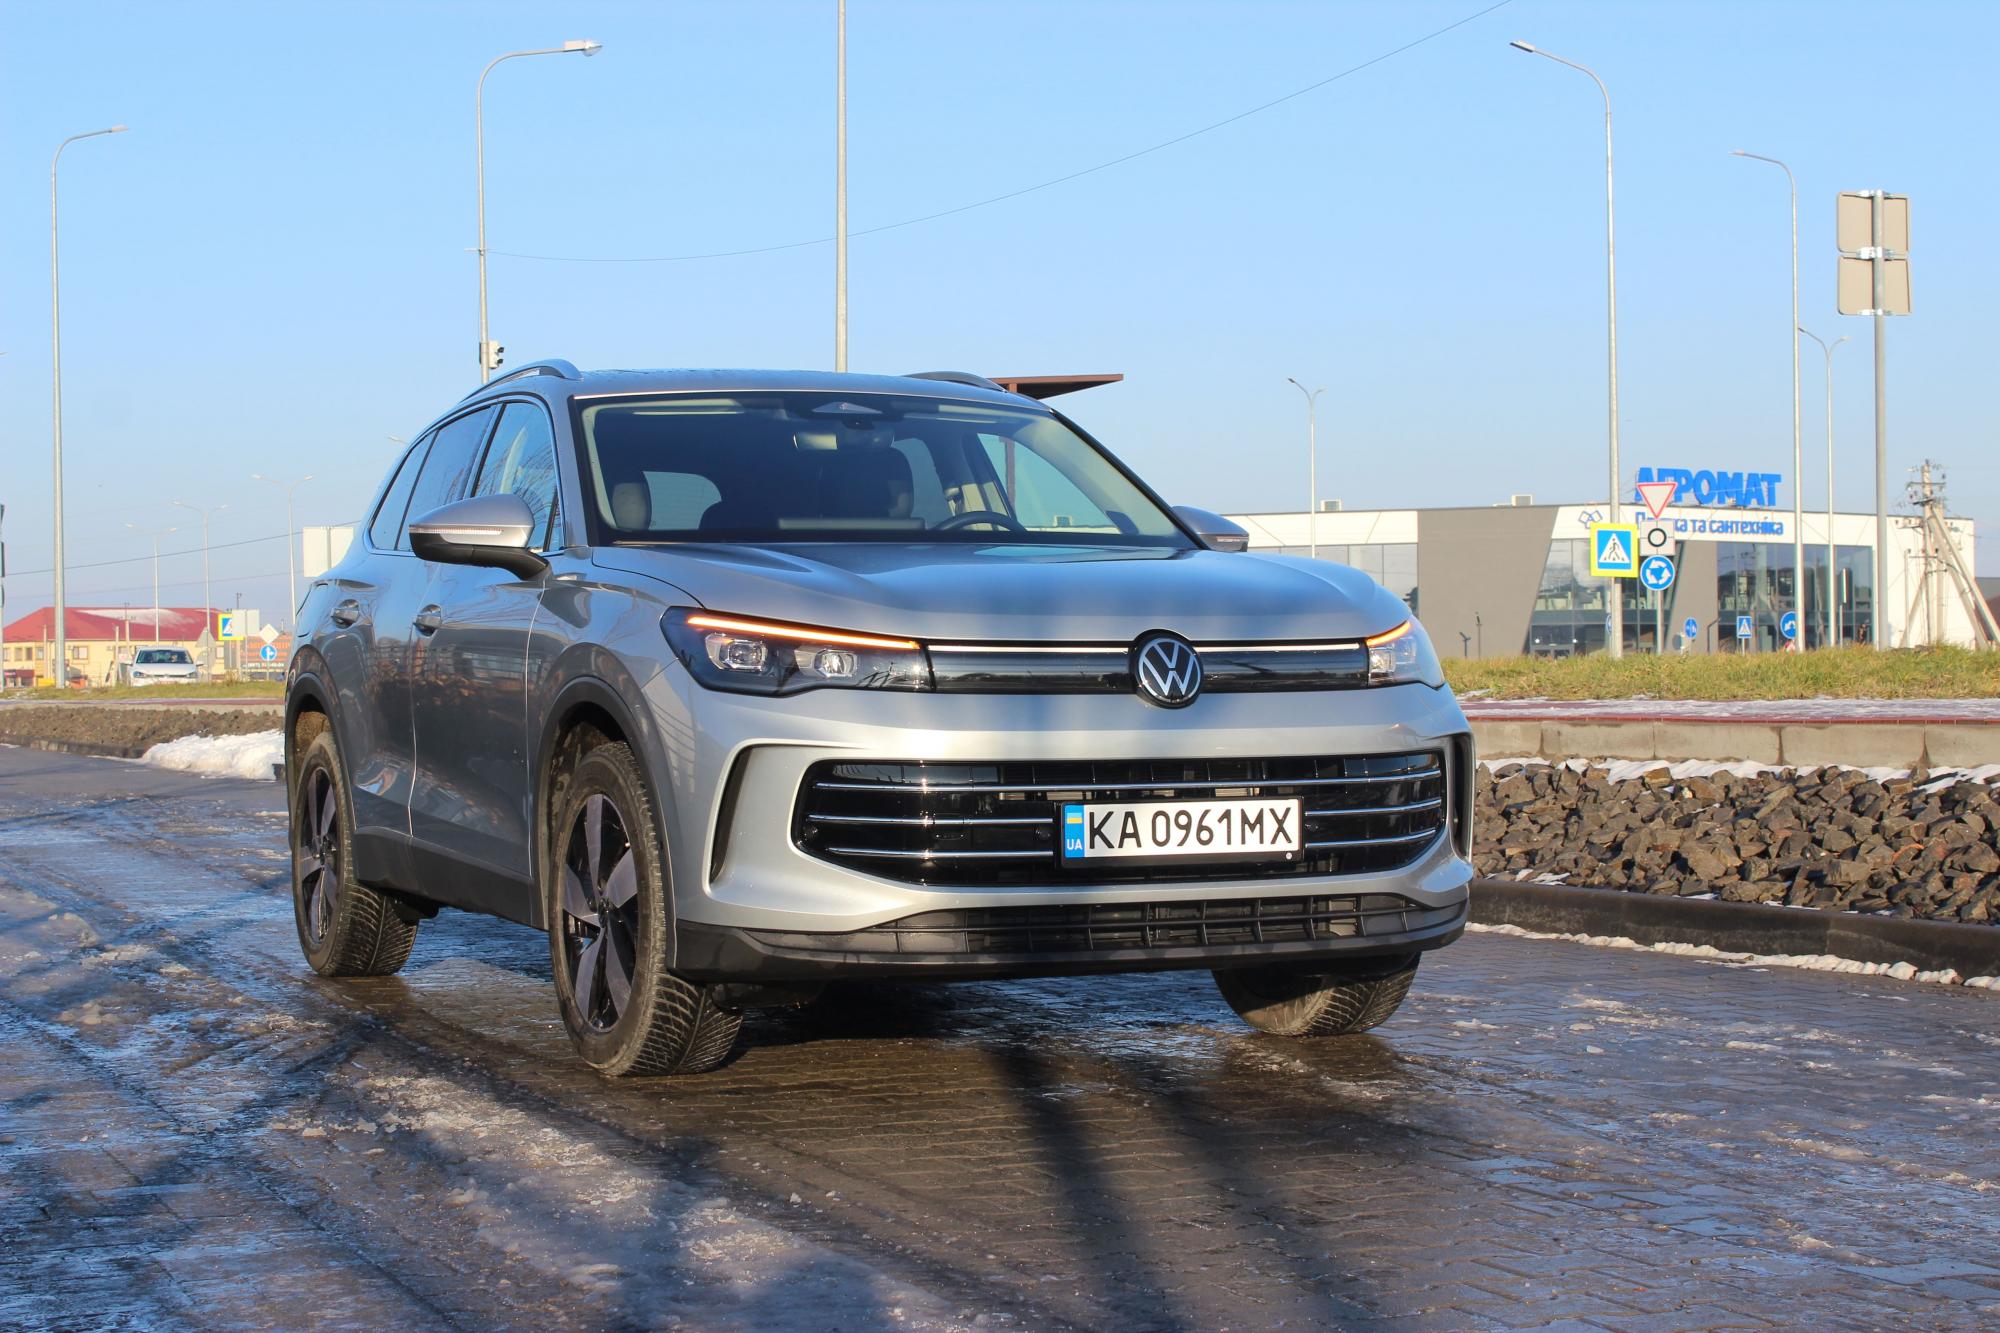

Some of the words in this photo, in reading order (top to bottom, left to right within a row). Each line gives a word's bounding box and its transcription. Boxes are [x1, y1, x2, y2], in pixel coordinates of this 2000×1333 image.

[1691, 518, 1706, 533] та
[1709, 518, 1784, 535] сантехніка
[1151, 809, 1232, 847] 0961
[1067, 839, 1083, 850] UA
